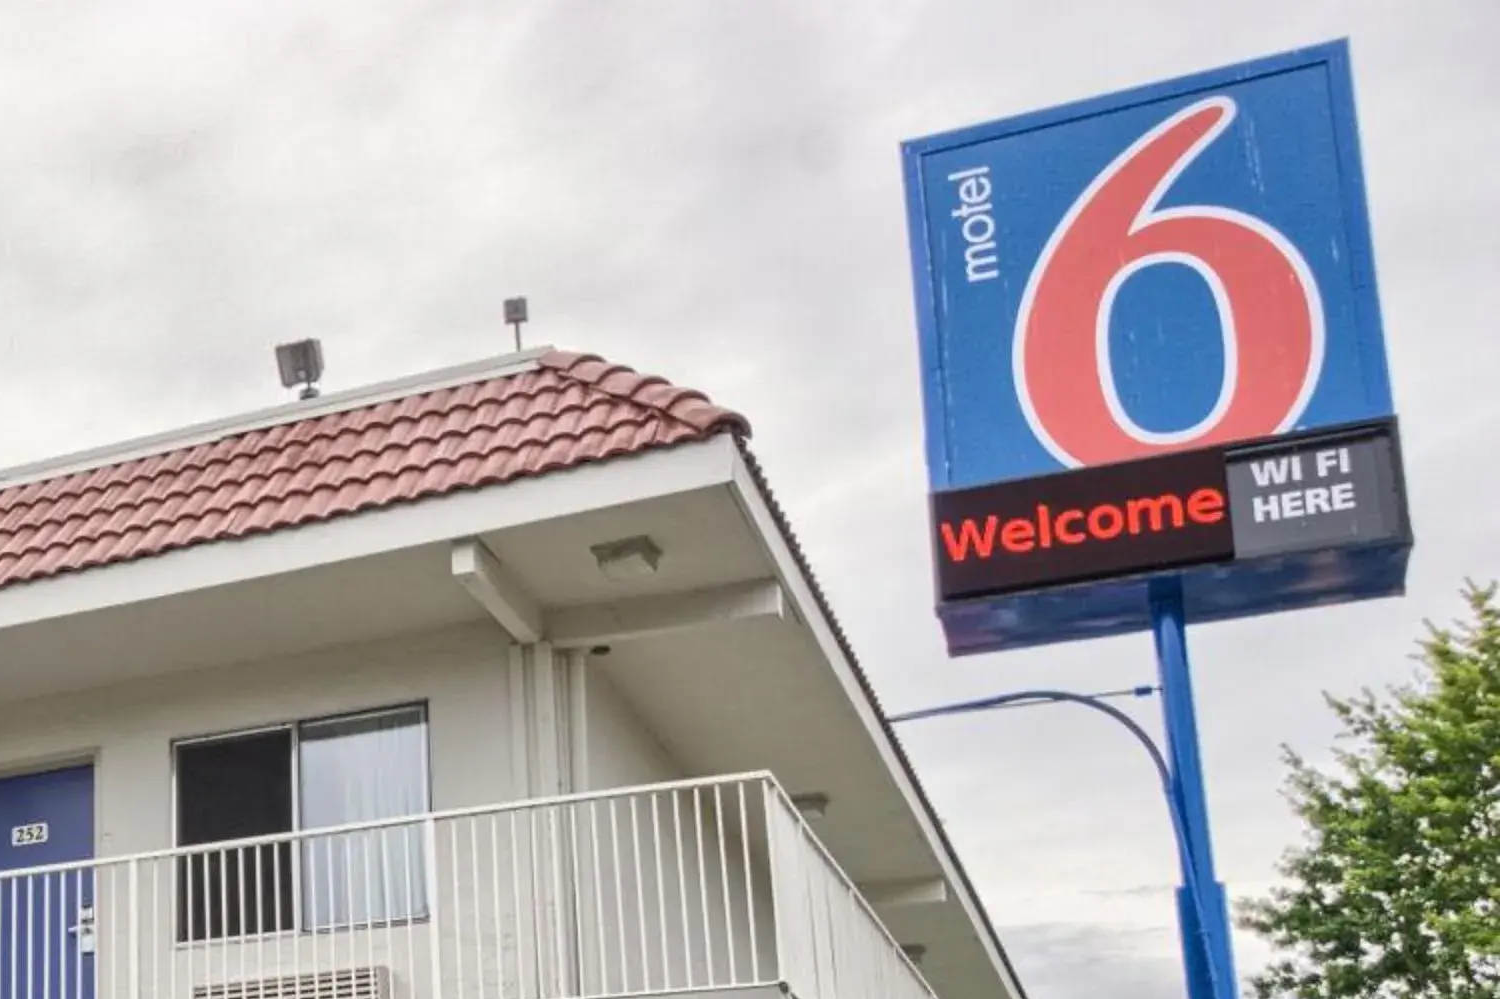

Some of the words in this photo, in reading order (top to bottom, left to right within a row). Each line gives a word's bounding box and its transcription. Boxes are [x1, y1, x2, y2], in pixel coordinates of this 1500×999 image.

[948, 165, 999, 283] motel
[1011, 95, 1326, 469] 6
[1250, 454, 1301, 487] WI
[1316, 447, 1351, 477] FI
[941, 486, 1225, 562] Welcome
[1252, 483, 1356, 524] HERE
[15, 825, 44, 842] 252
